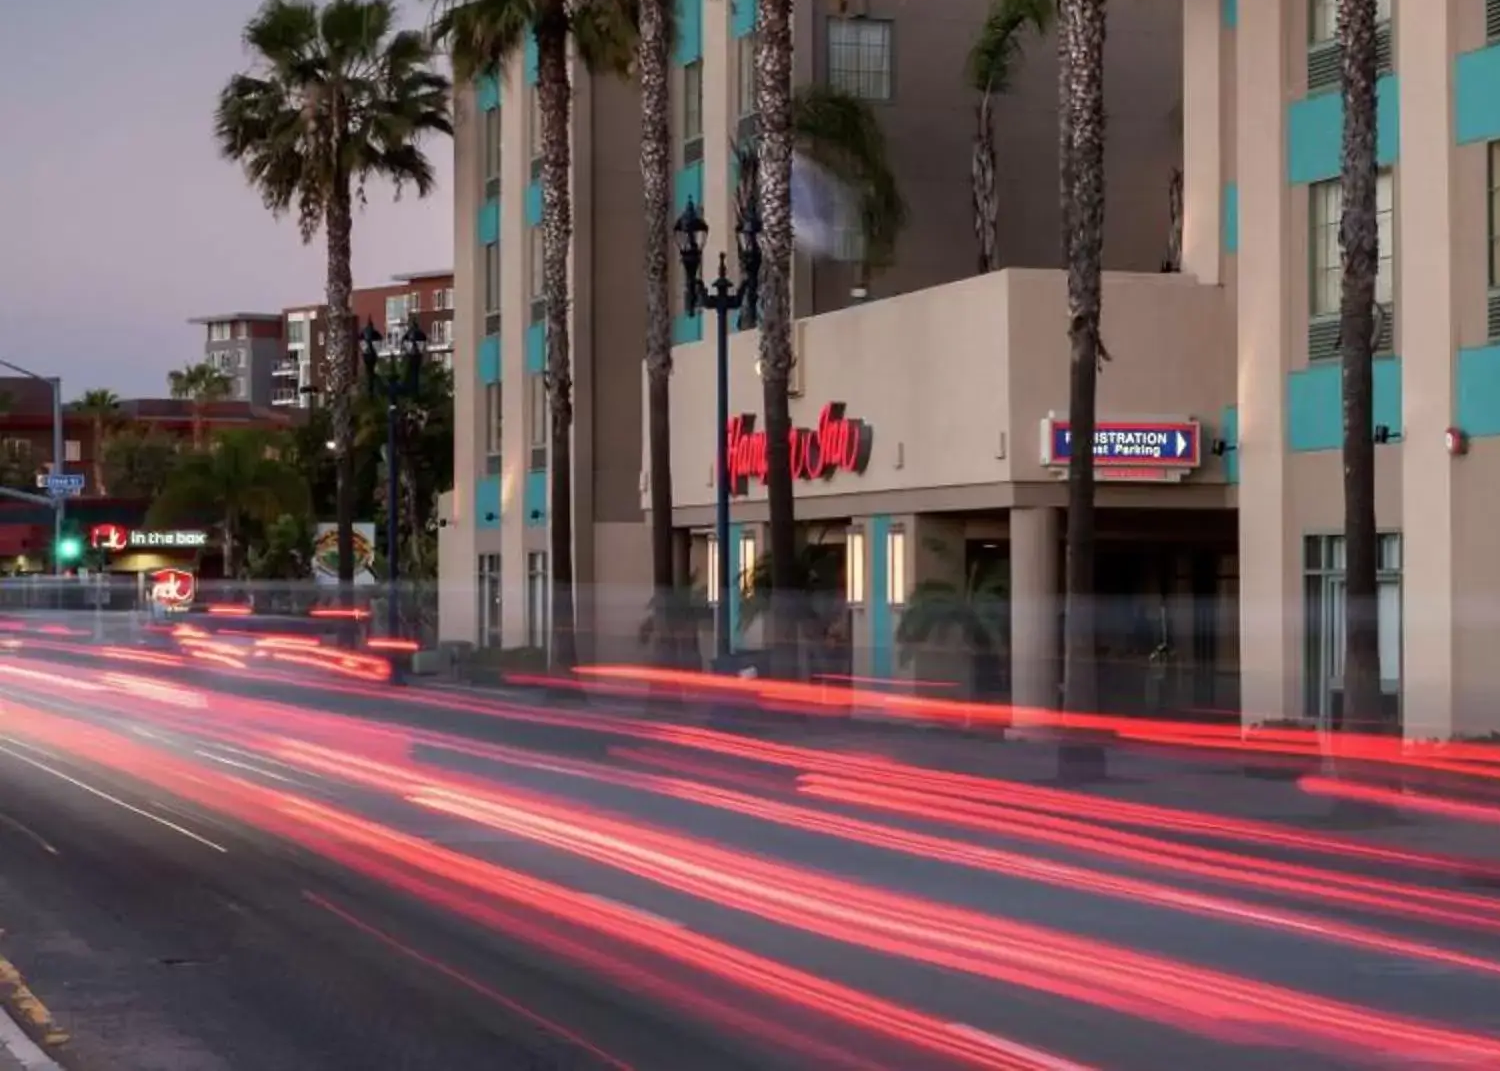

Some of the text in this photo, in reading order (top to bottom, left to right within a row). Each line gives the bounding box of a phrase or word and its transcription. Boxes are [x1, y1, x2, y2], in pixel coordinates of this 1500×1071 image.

[1115, 444, 1161, 457] Parking
[131, 530, 146, 544] in
[148, 531, 174, 544] the
[175, 531, 206, 545] box
